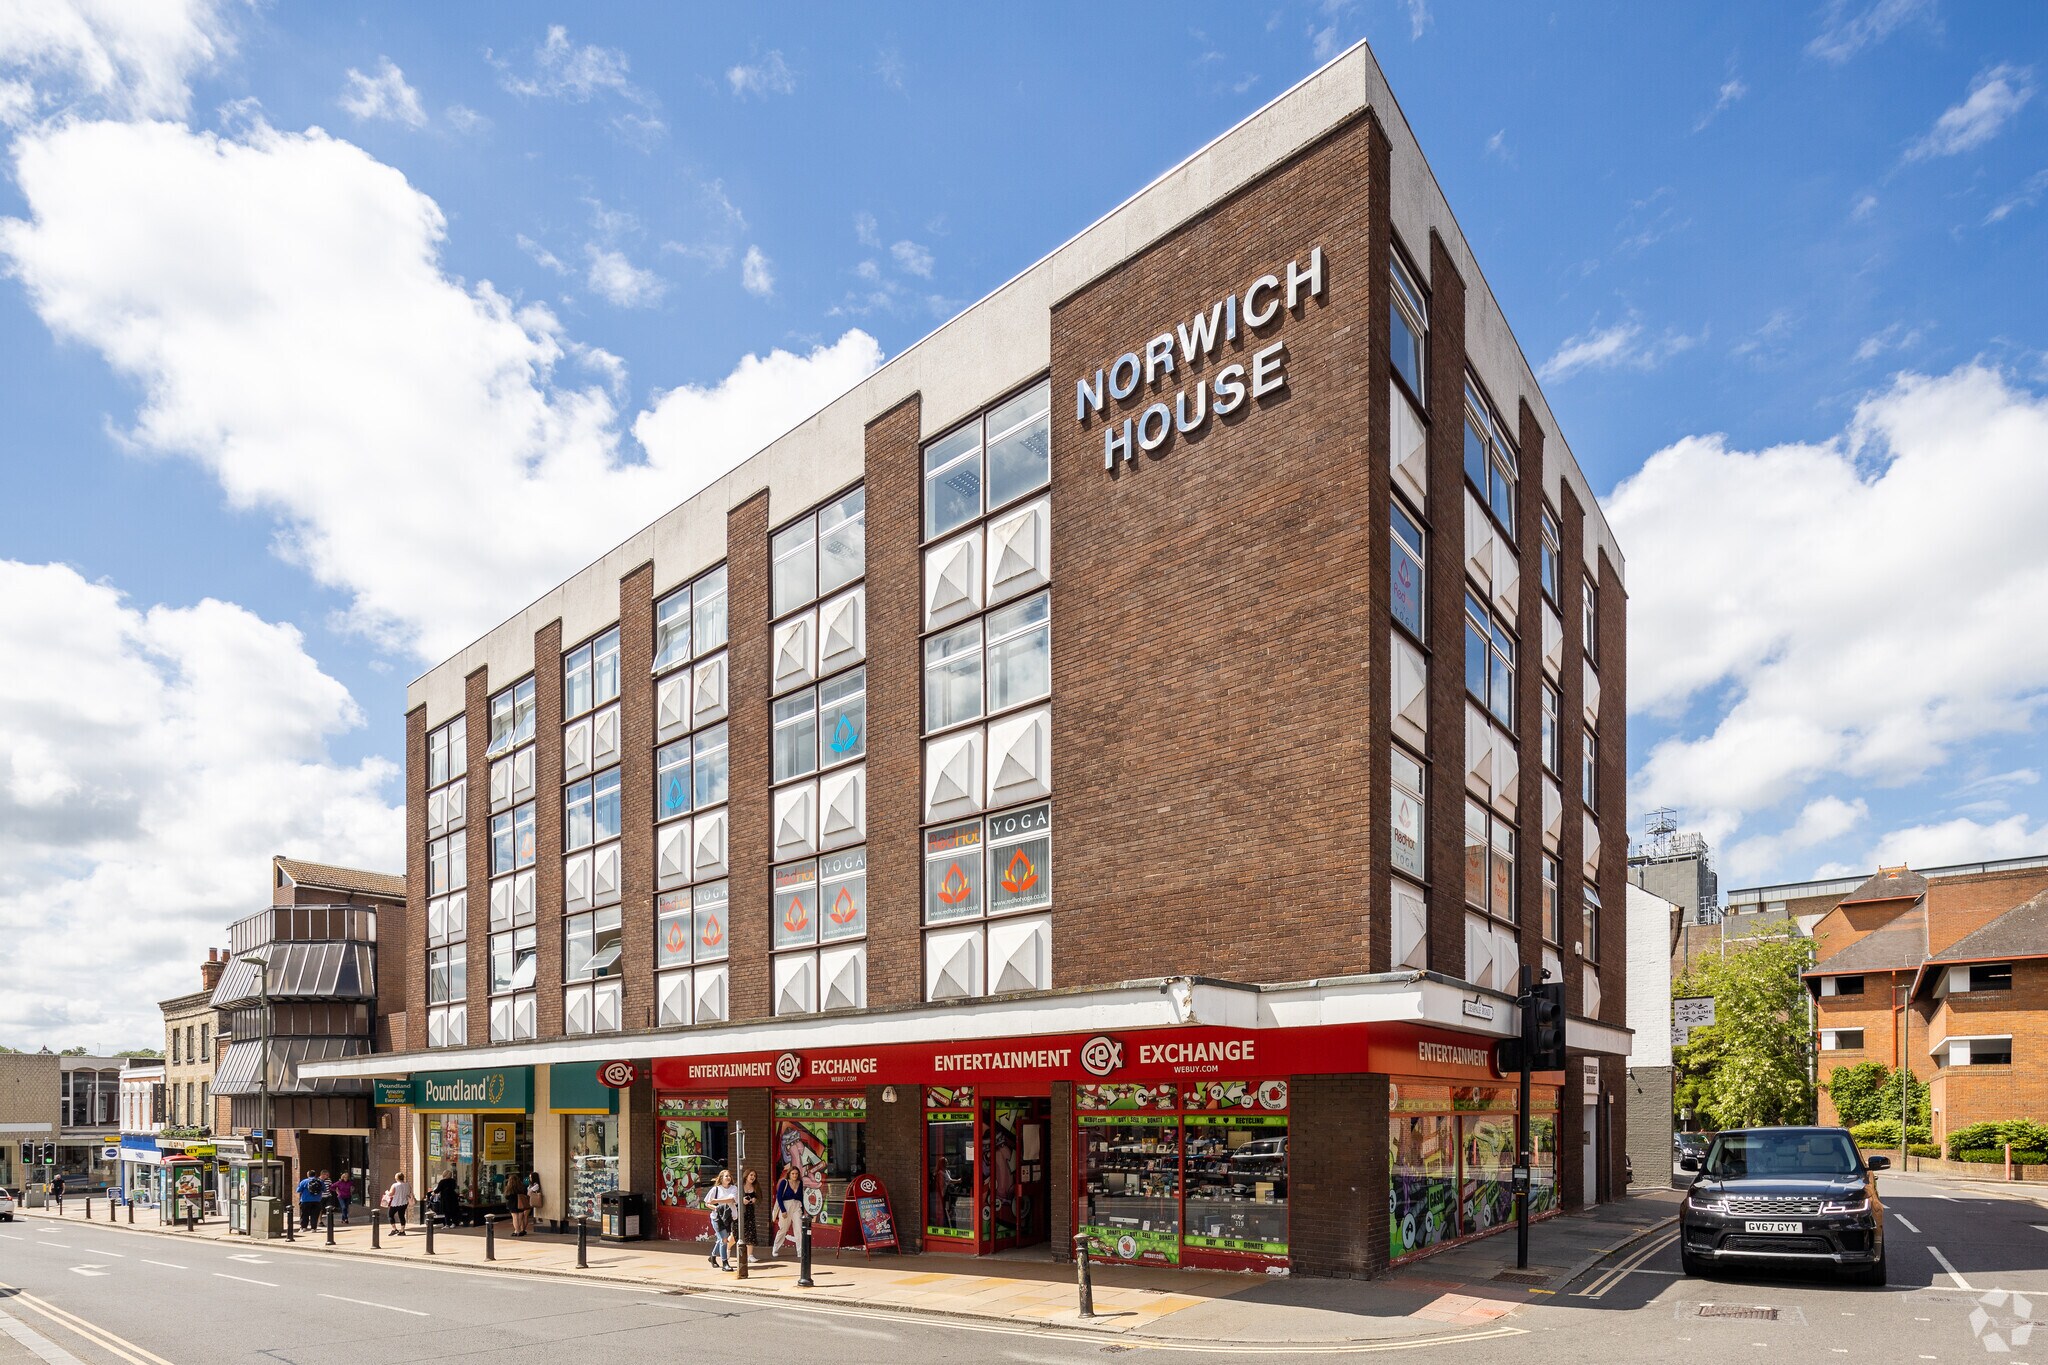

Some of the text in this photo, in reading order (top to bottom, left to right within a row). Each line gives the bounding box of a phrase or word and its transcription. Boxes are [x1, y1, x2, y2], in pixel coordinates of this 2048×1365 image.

[1077, 246, 1322, 421] NORWICH
[1105, 341, 1284, 470] HOUSE
[993, 811, 1047, 836] YOGA
[824, 854, 863, 874] YOGA
[1396, 851, 1414, 870] YOGA
[697, 887, 728, 902] YOGA
[993, 892, 1048, 907] www.redhotyoga.co.uk
[934, 1049, 1072, 1071] ENTERTAINMENT
[1139, 1040, 1255, 1064] EXCHANGE
[1419, 1041, 1488, 1067] ENTERTAINMENT
[689, 1062, 772, 1078] ENTERTAINMENT
[811, 1058, 877, 1075] EXCHANGE
[1174, 1065, 1219, 1073] WEBUY.COM
[426, 1078, 486, 1102] Poundland
[1235, 1117, 1264, 1125] RECYCLING
[1430, 1190, 1443, 1210] CASH
[1748, 1223, 1797, 1232] GV67 GYY
[1206, 1238, 1264, 1250] BUY SELL DONATE
